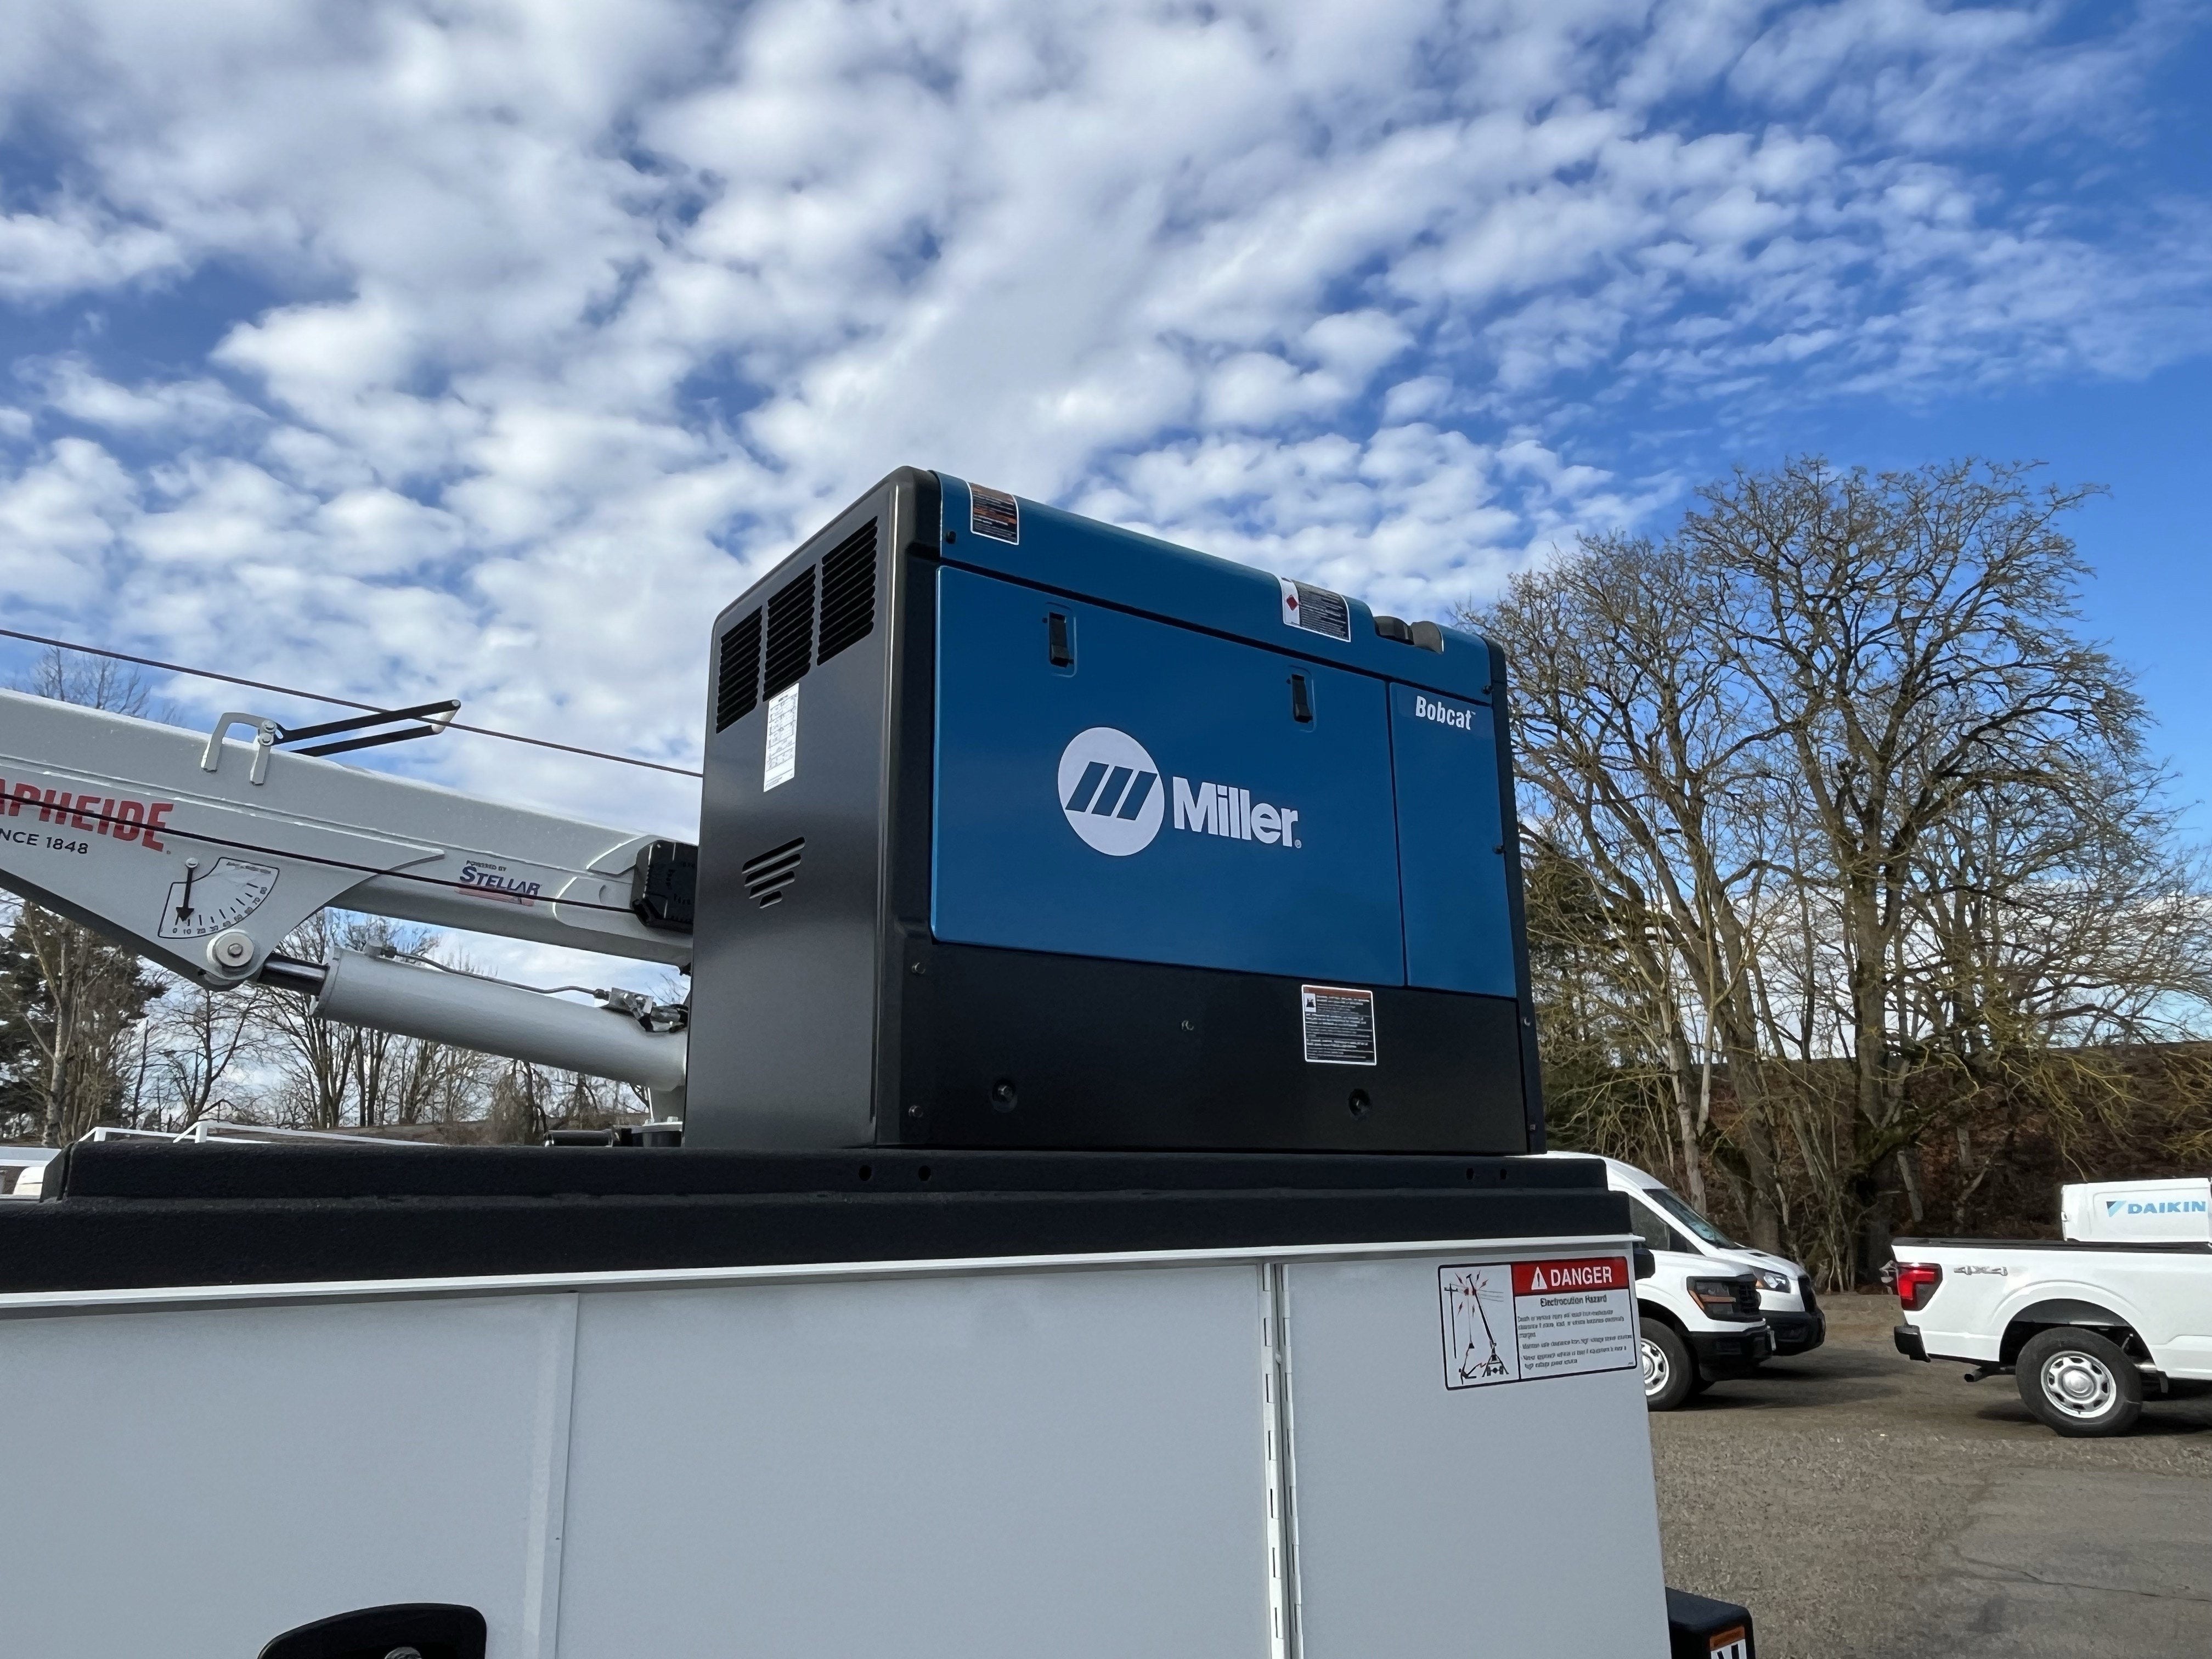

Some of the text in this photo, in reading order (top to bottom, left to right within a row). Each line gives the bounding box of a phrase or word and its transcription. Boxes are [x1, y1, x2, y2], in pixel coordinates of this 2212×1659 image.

[1415, 695, 1472, 731] Bobcat
[1172, 776, 1299, 848] Miller
[46, 837, 88, 854] 1848
[459, 866, 541, 896] STELLAR
[2128, 1201, 2207, 1214] DAIKIN
[1550, 1266, 1612, 1287] DANGER
[1540, 1294, 1607, 1308] Electrocution Hazard
